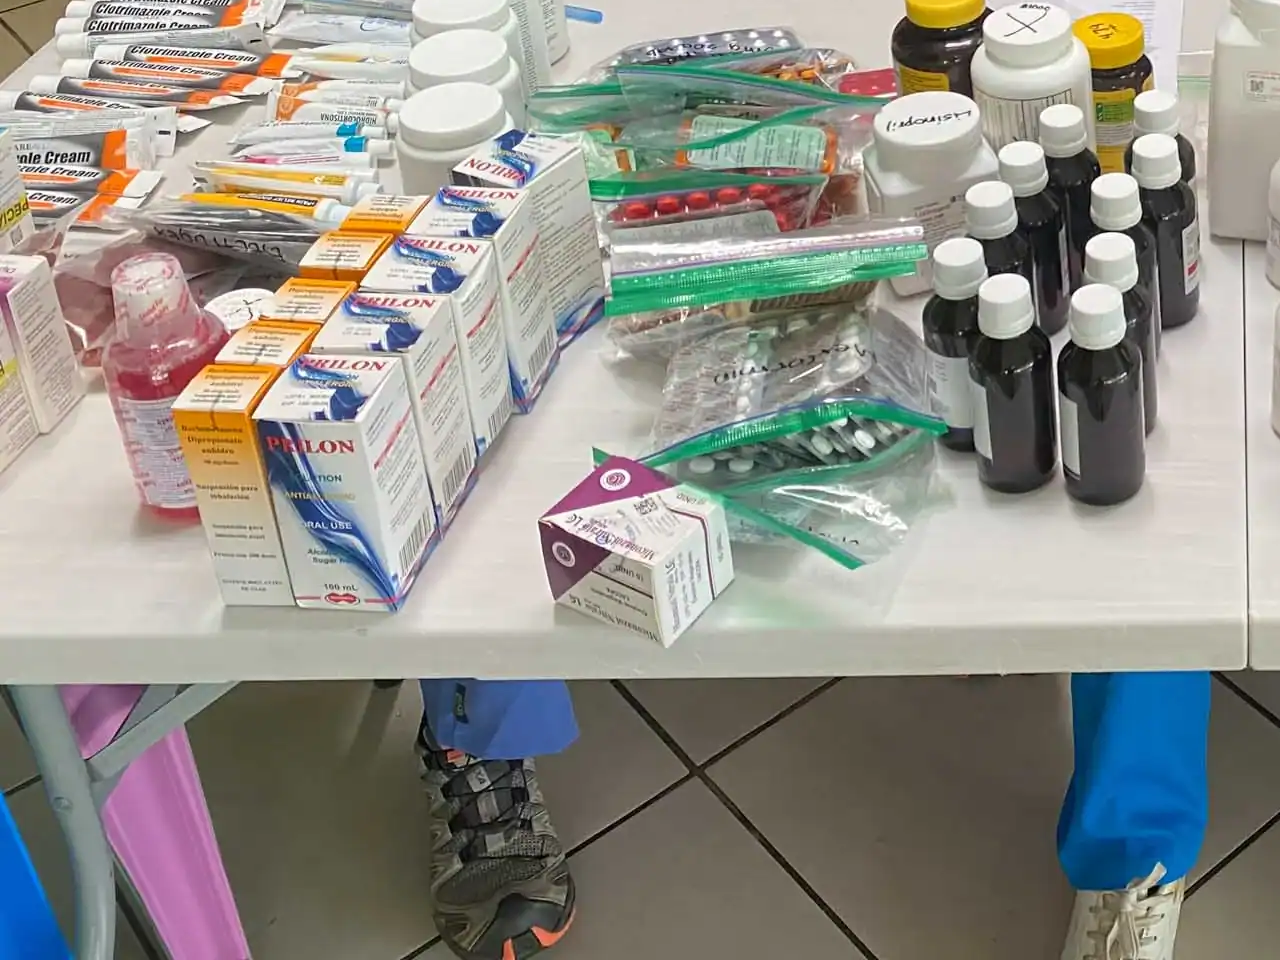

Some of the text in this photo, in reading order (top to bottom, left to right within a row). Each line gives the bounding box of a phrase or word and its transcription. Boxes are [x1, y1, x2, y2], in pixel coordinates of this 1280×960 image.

[96, 4, 174, 17] Clotrimazole
[88, 20, 167, 32] Clotrimazole
[130, 46, 258, 63] Clotrimazole Cream
[180, 66, 224, 78] Cream
[320, 113, 377, 125] HIDROCORTISONA
[886, 110, 973, 133] Lisinopril
[45, 151, 92, 165] Cream
[54, 167, 101, 179] Cream
[464, 158, 527, 182] PRILON
[29, 192, 80, 205] Cream
[445, 189, 520, 200] PRILON
[404, 238, 481, 255] PRILON
[354, 295, 437, 309] PRILON
[302, 358, 388, 371] PRILON
[265, 435, 355, 455] PRILON
[302, 521, 353, 530] ORAL USE
[312, 556, 338, 565] Sugar
